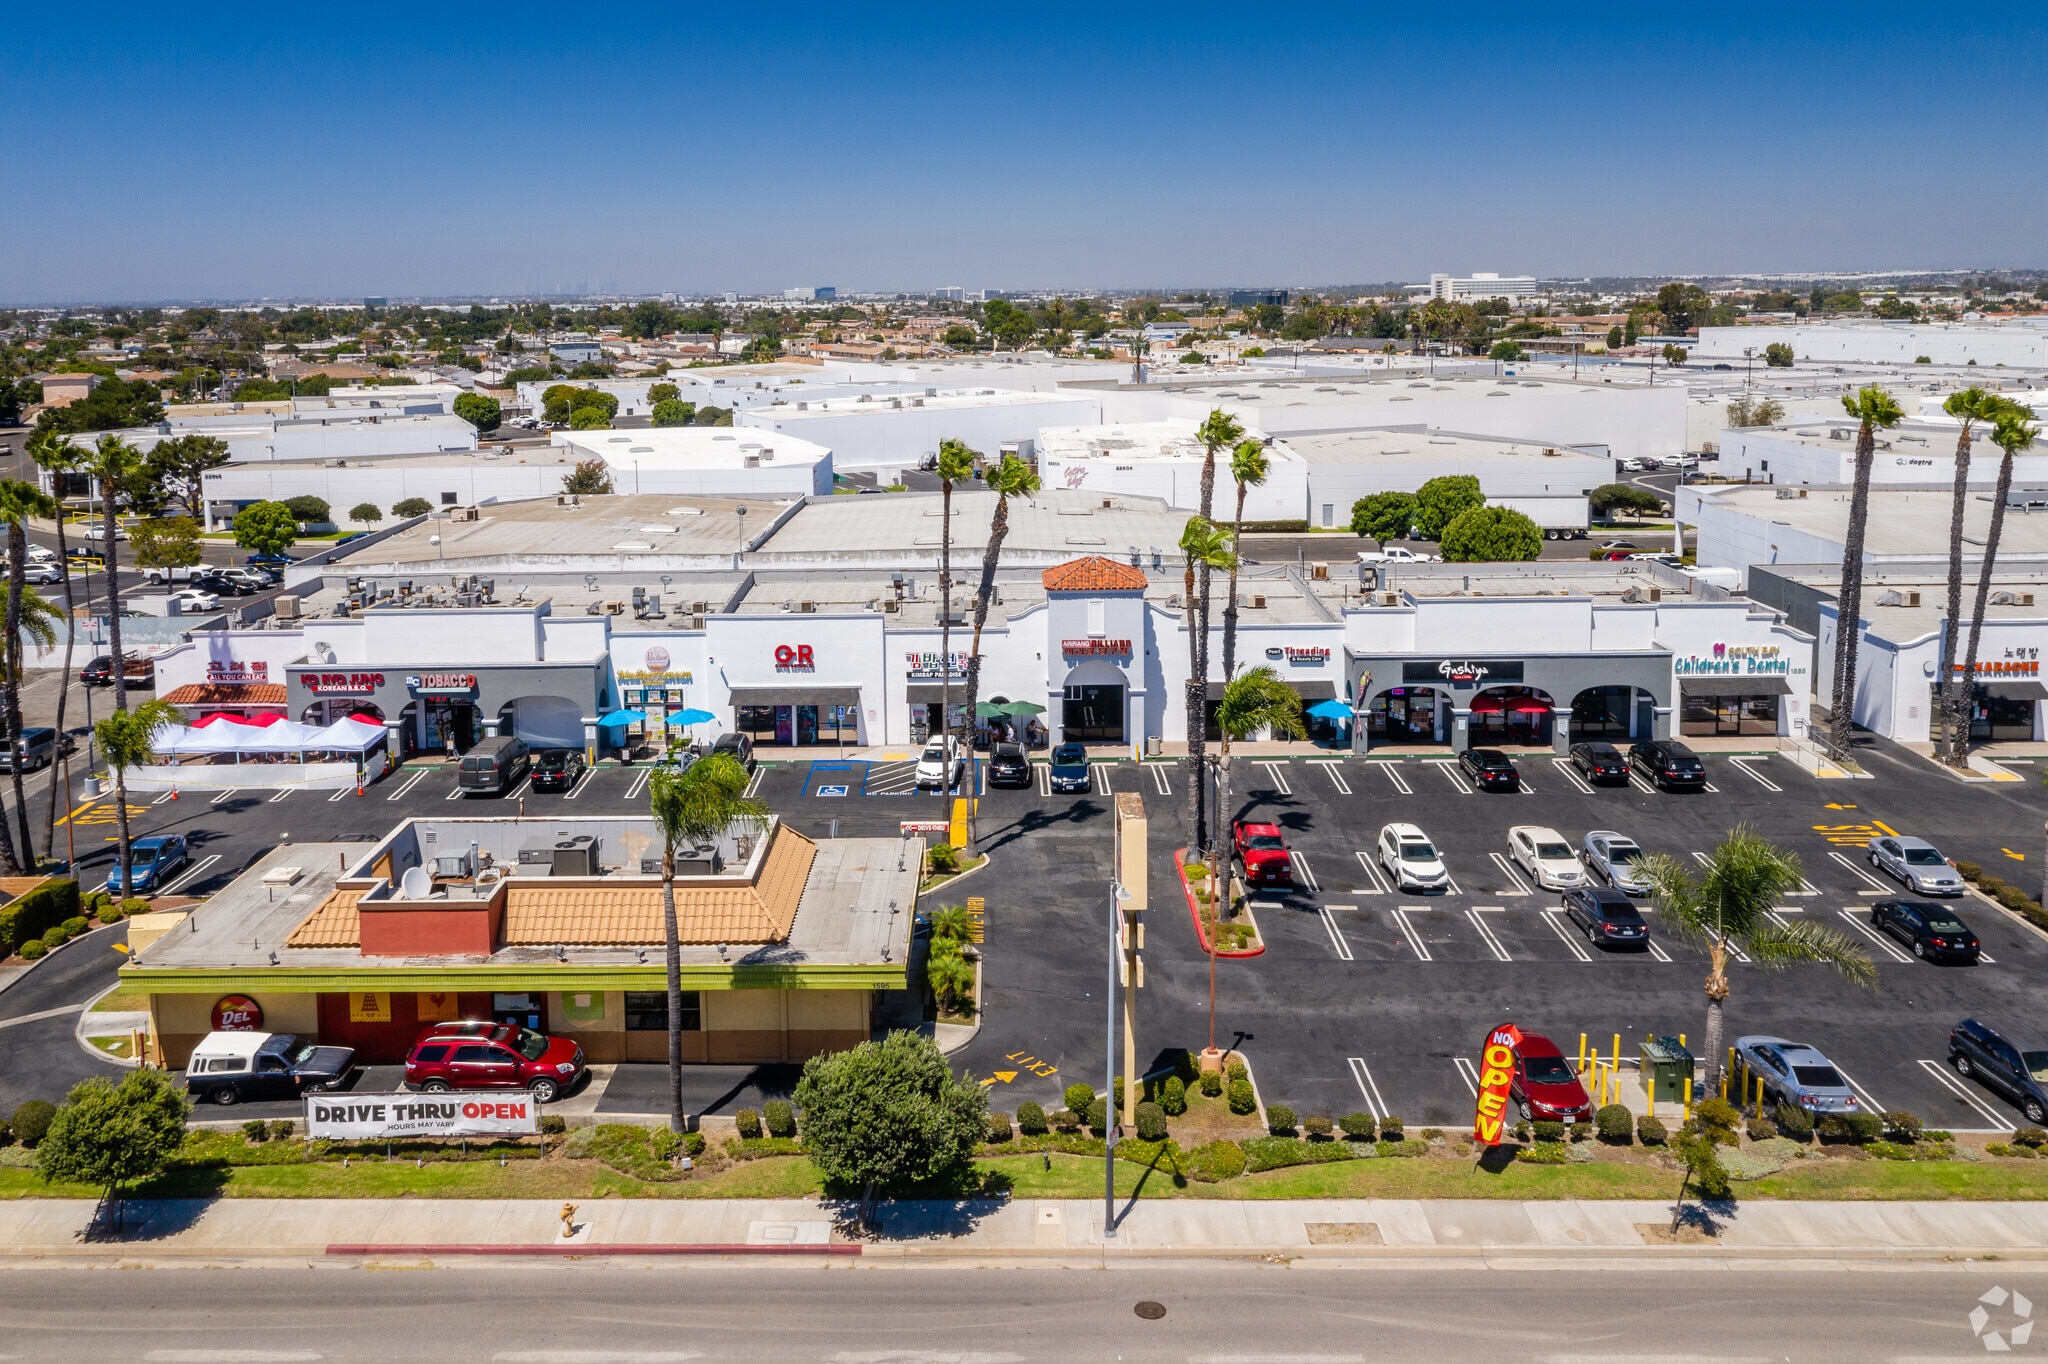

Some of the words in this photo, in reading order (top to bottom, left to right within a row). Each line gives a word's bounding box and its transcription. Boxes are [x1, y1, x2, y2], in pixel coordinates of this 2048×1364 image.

[1284, 646, 1331, 656] Threading
[1728, 646, 1759, 655] SOUTH
[1761, 646, 1780, 655] BAY
[2004, 647, 2039, 659] 노래방
[1439, 659, 1489, 681] Gushiya
[1675, 656, 1740, 672] Children's
[1747, 656, 1791, 674] Dental
[1974, 661, 2039, 672] KARAOKE
[301, 673, 319, 685] KO
[321, 673, 346, 685] RYO
[348, 673, 384, 685] JUNG
[420, 673, 475, 688] TOBACCO
[222, 1011, 251, 1025] DEL
[1005, 1051, 1059, 1077] EXIT
[1474, 1045, 1514, 1142] OPEN
[315, 1104, 386, 1122] DRIVE
[392, 1103, 456, 1121] THRU
[462, 1102, 526, 1119] OPEN
[387, 1122, 416, 1131] HOURS
[418, 1121, 434, 1129] MAY
